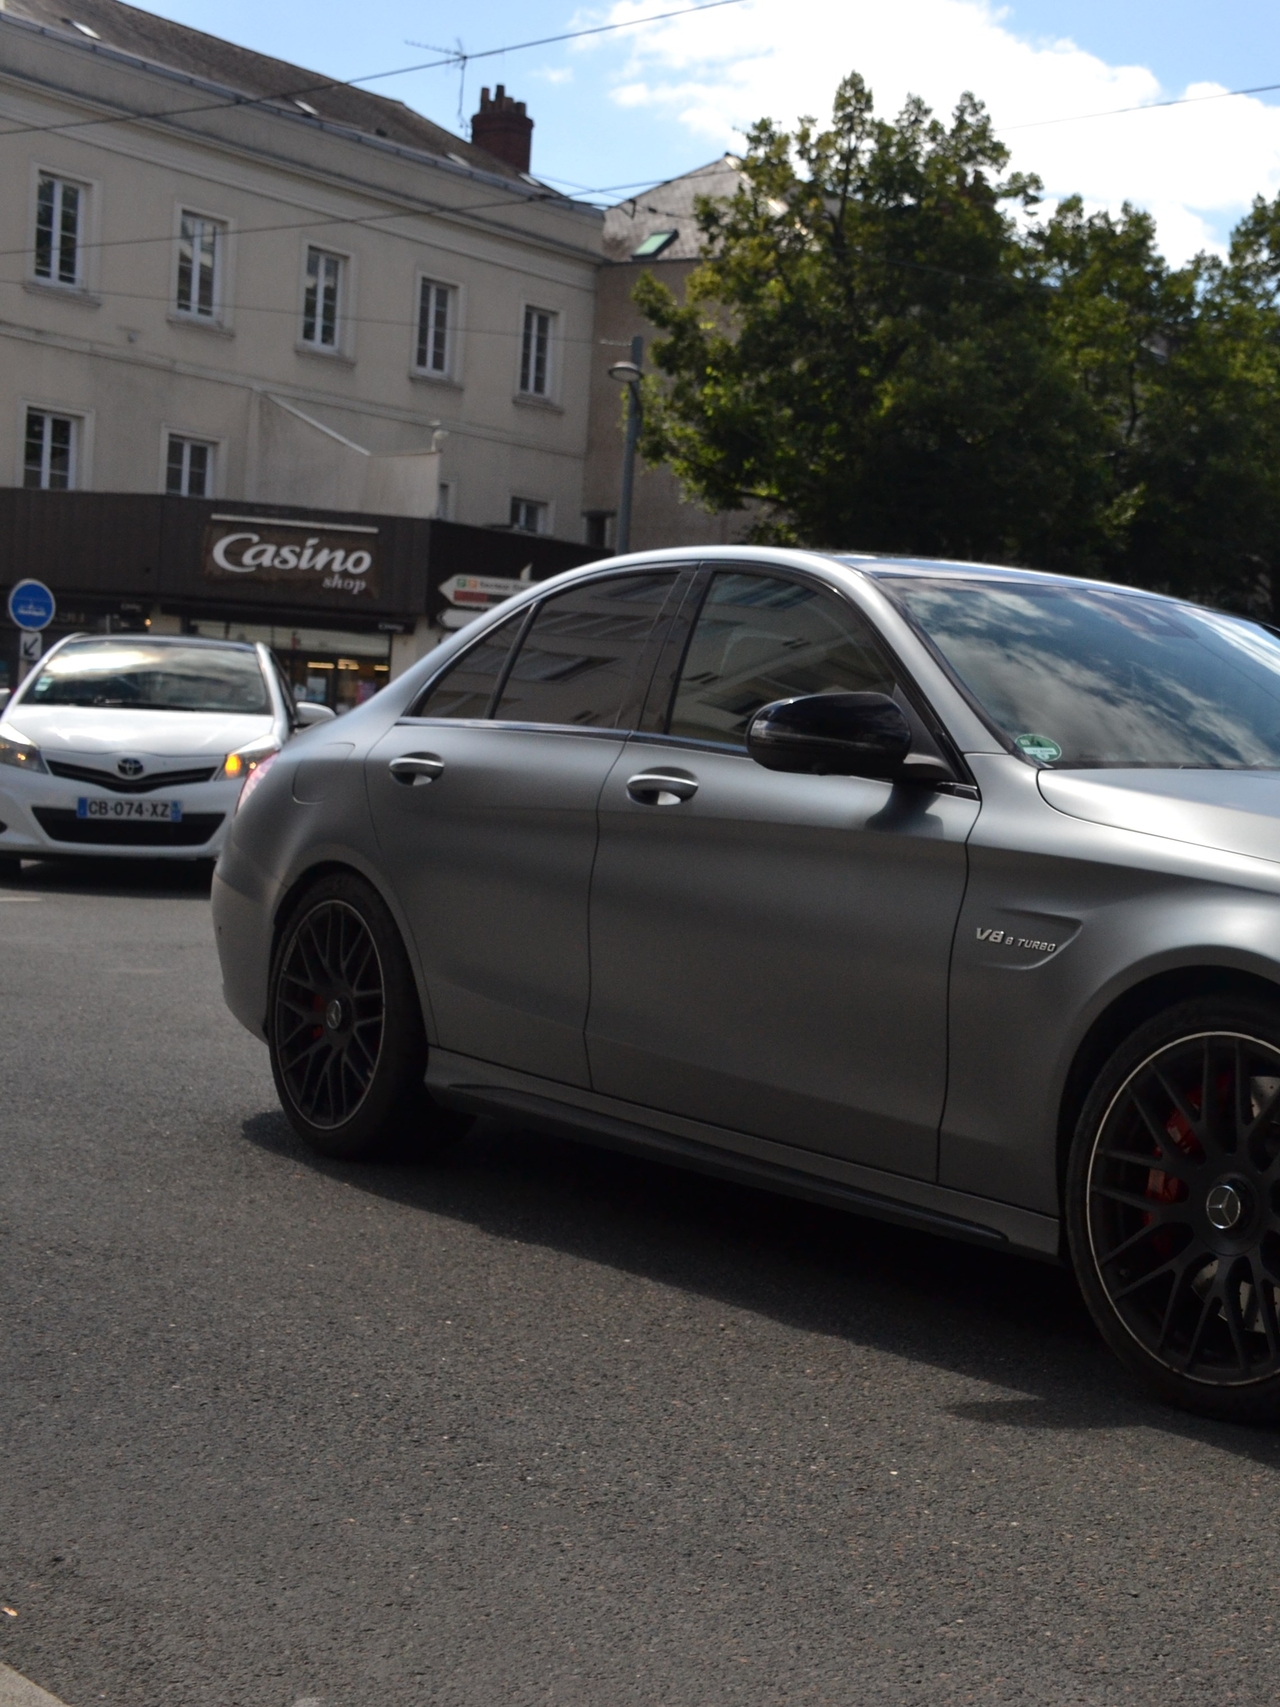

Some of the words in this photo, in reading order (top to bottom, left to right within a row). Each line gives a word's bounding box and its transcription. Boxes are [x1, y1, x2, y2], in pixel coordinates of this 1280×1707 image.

[212, 532, 372, 575] Casino
[321, 573, 367, 595] shop
[976, 927, 1004, 943] V8
